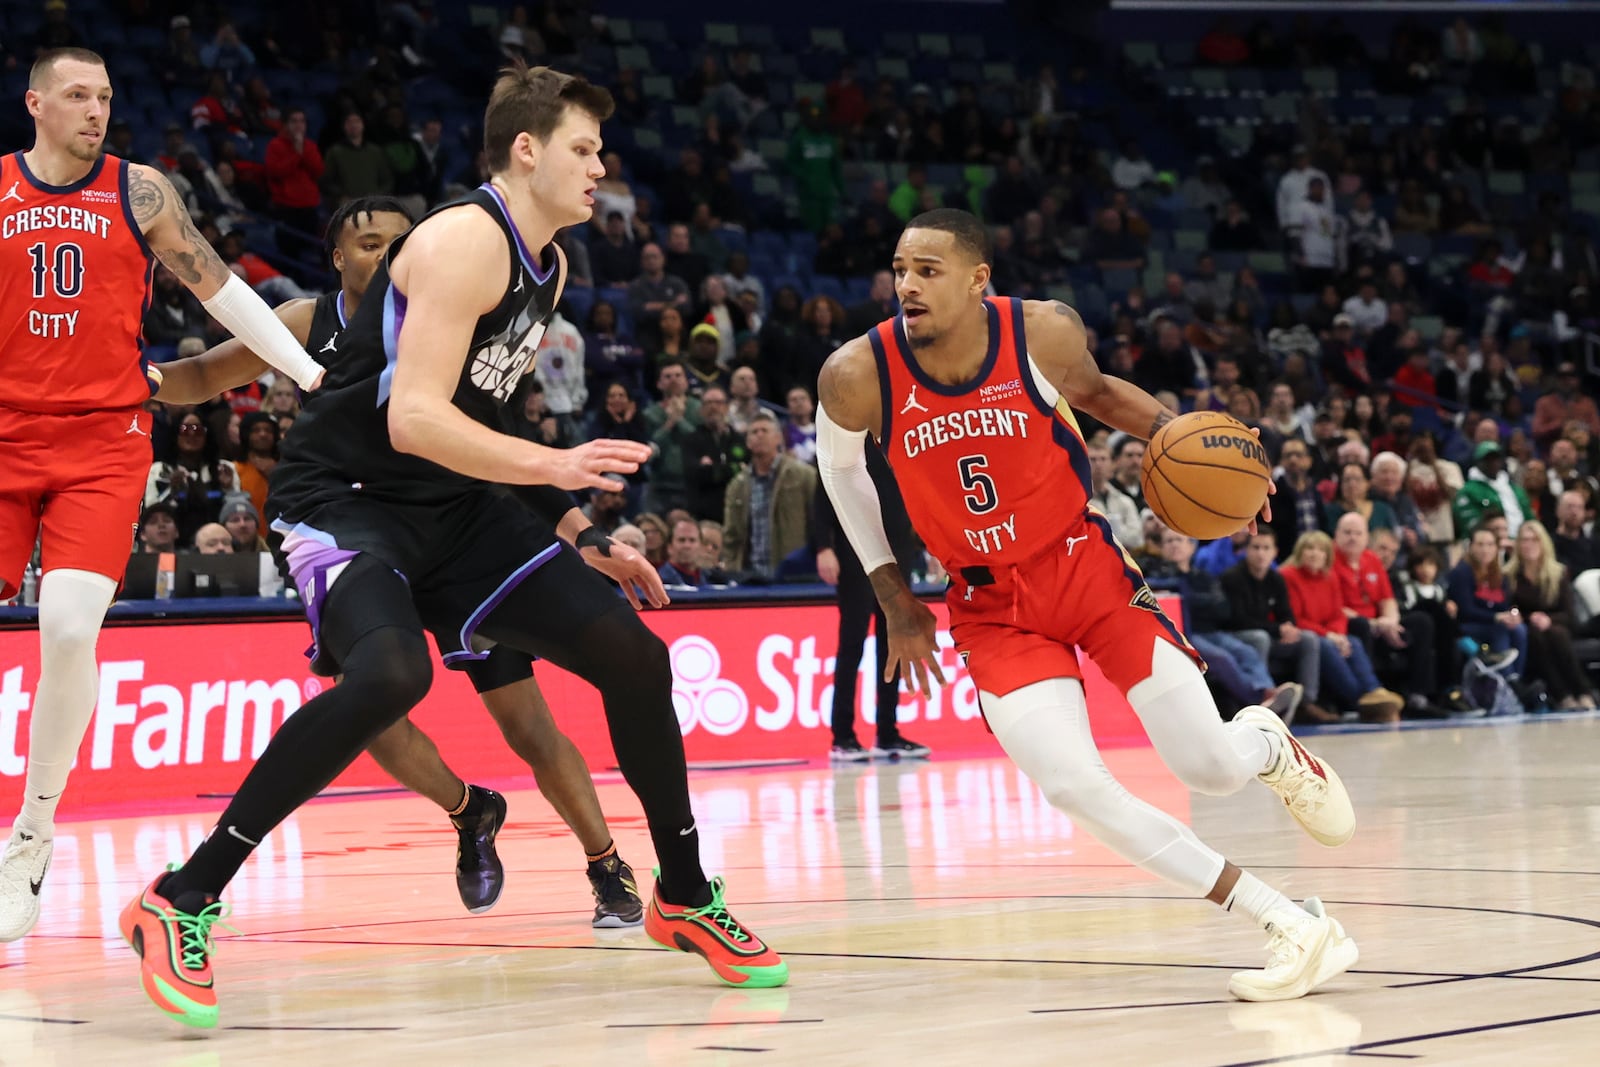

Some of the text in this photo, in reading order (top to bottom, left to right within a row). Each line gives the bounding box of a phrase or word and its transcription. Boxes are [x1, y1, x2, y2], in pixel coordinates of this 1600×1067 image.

[81, 189, 117, 199] NEWAGE
[3, 206, 111, 239] CRESCENT
[27, 242, 85, 298] 10
[28, 309, 80, 339] CITY
[979, 379, 1020, 396] NEWAGE
[981, 389, 1023, 404] PRODUCTS
[904, 409, 1028, 458] CRESCENT
[957, 454, 999, 515] 5
[964, 514, 1016, 554] CITY
